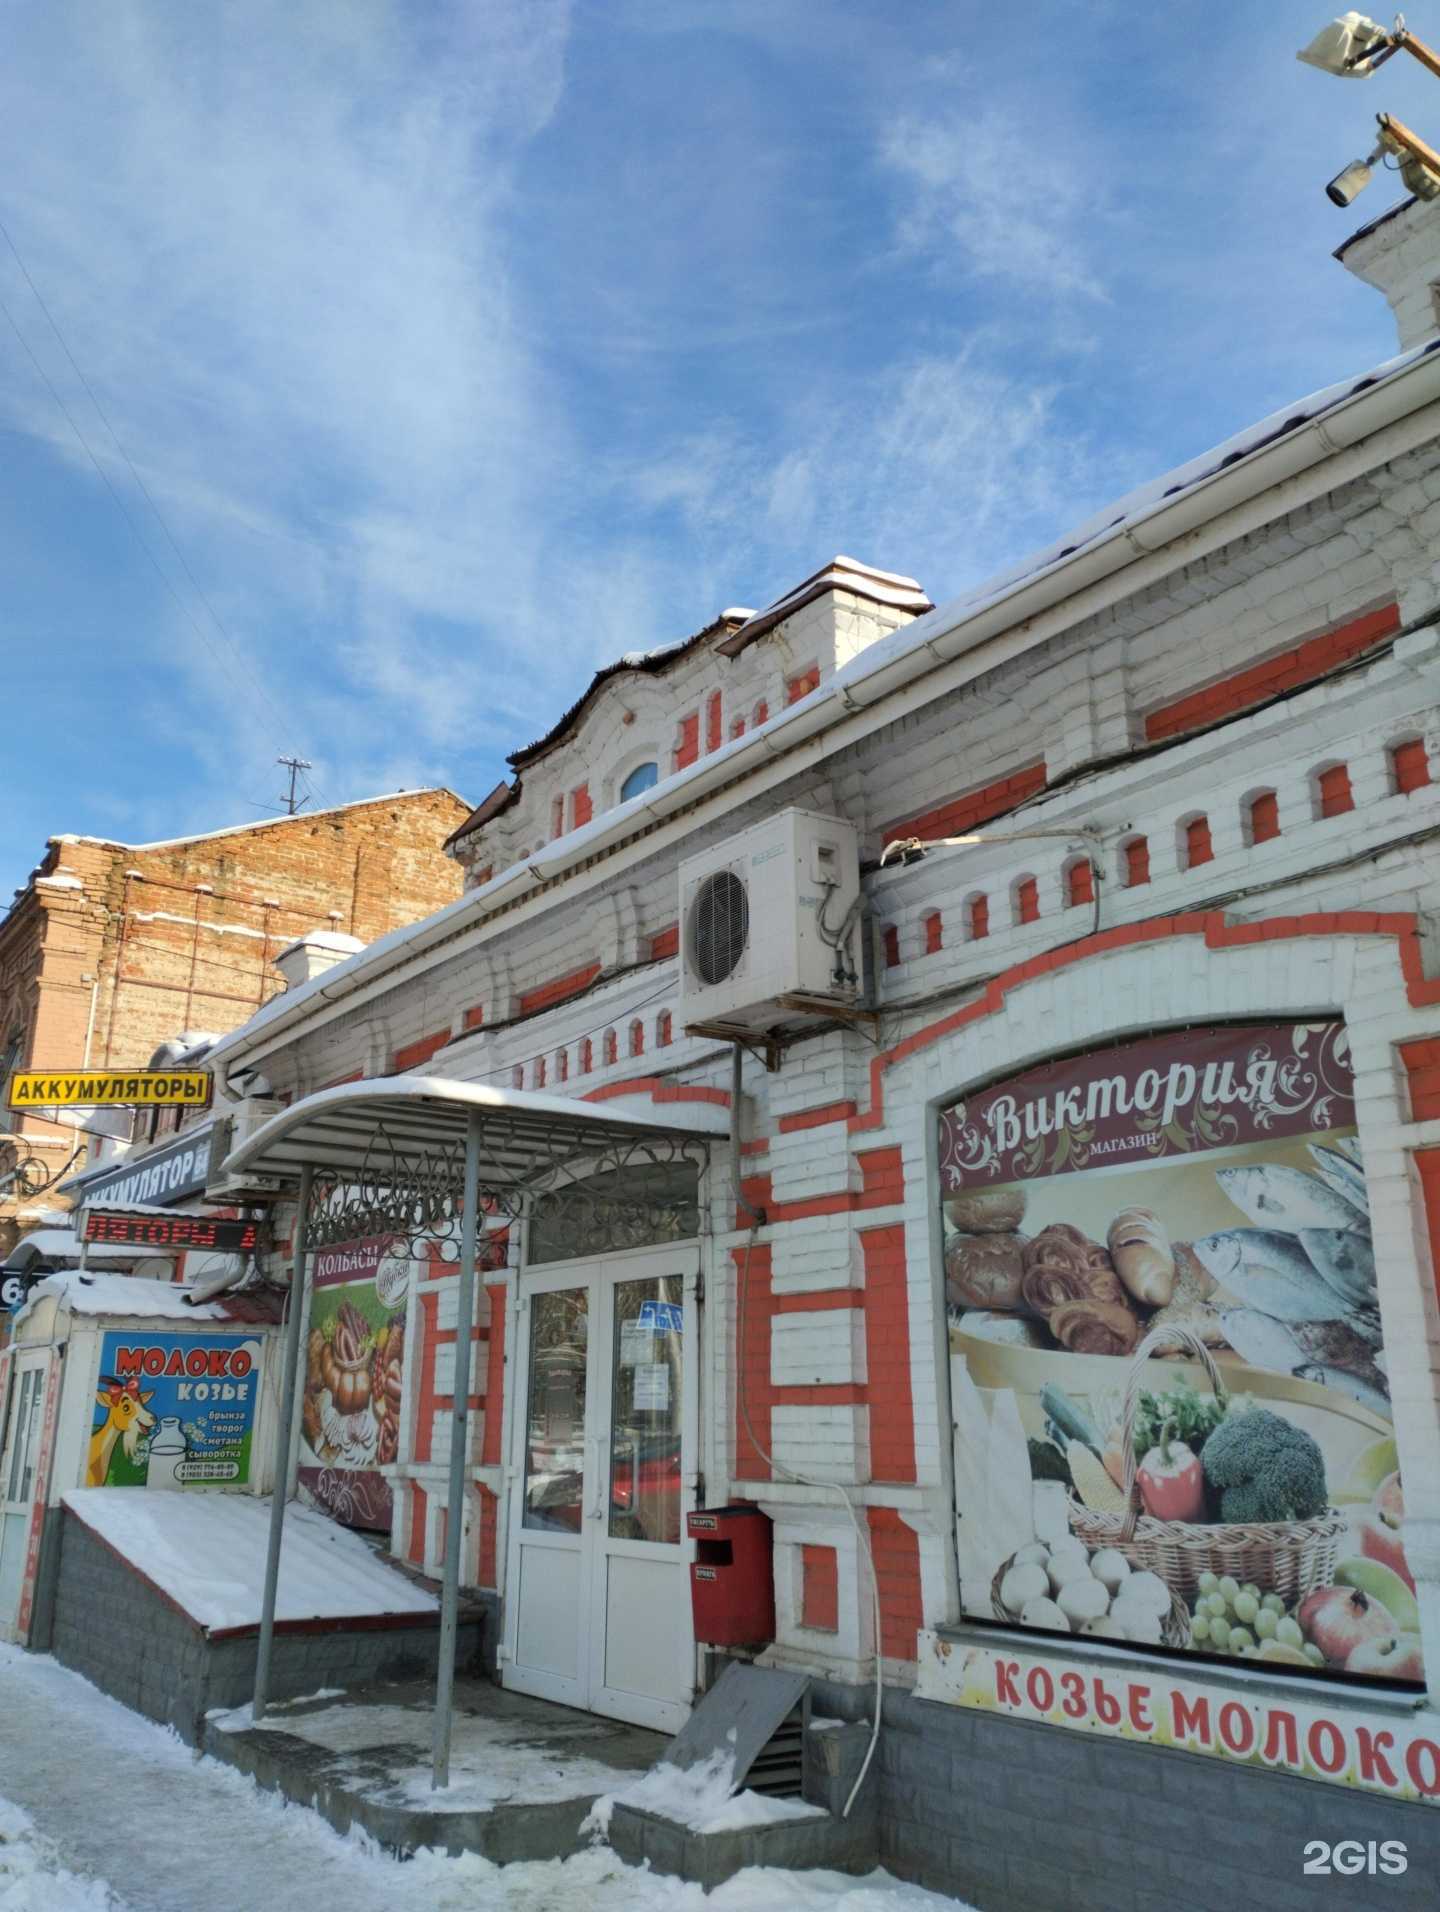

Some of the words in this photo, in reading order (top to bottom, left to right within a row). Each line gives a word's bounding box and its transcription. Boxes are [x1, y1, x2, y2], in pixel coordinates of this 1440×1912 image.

[16, 1078, 203, 1100] АККУМУЛЯТОРЫ
[994, 1057, 1278, 1153] Виктория
[1090, 1132, 1158, 1156] МАГАЗИН
[317, 1245, 379, 1277] КОЛБАСЫ
[115, 1346, 252, 1378] МОЛОКО
[177, 1383, 249, 1401] КОЗЬЕ
[208, 1410, 246, 1421] брынза
[212, 1424, 244, 1433] творог
[203, 1438, 242, 1446] сметана
[188, 1450, 241, 1459] сыворотка
[995, 1658, 1154, 1733] КОЗЬЕ
[1170, 1689, 1440, 1797] МОЛОКО
